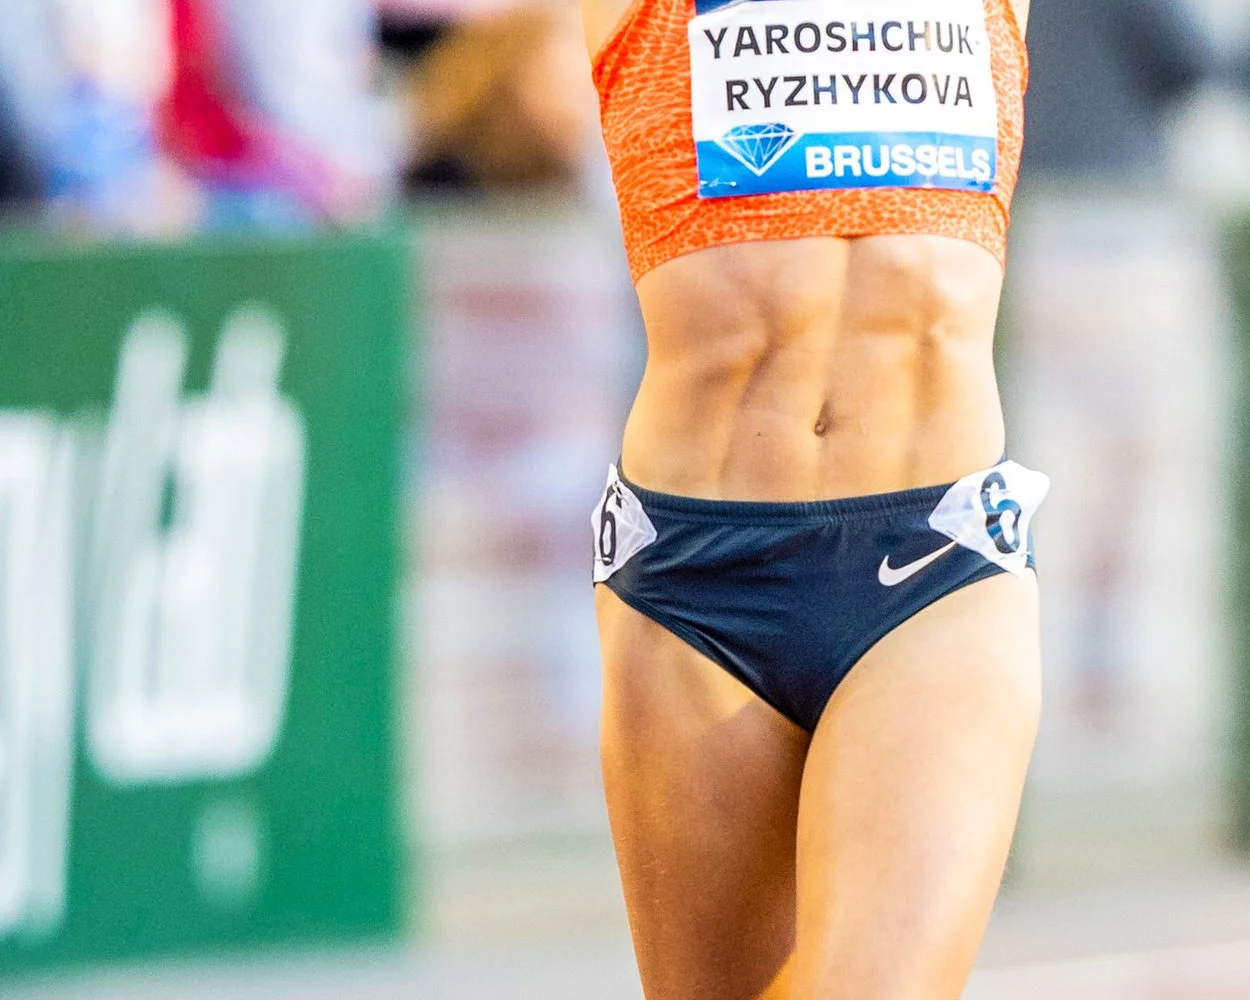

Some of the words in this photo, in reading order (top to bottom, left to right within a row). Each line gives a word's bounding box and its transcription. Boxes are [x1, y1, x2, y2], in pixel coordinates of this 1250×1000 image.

[725, 72, 974, 112] RYZHYKOVA
[804, 144, 991, 179] BRUSSELS
[980, 471, 1022, 555] 6
